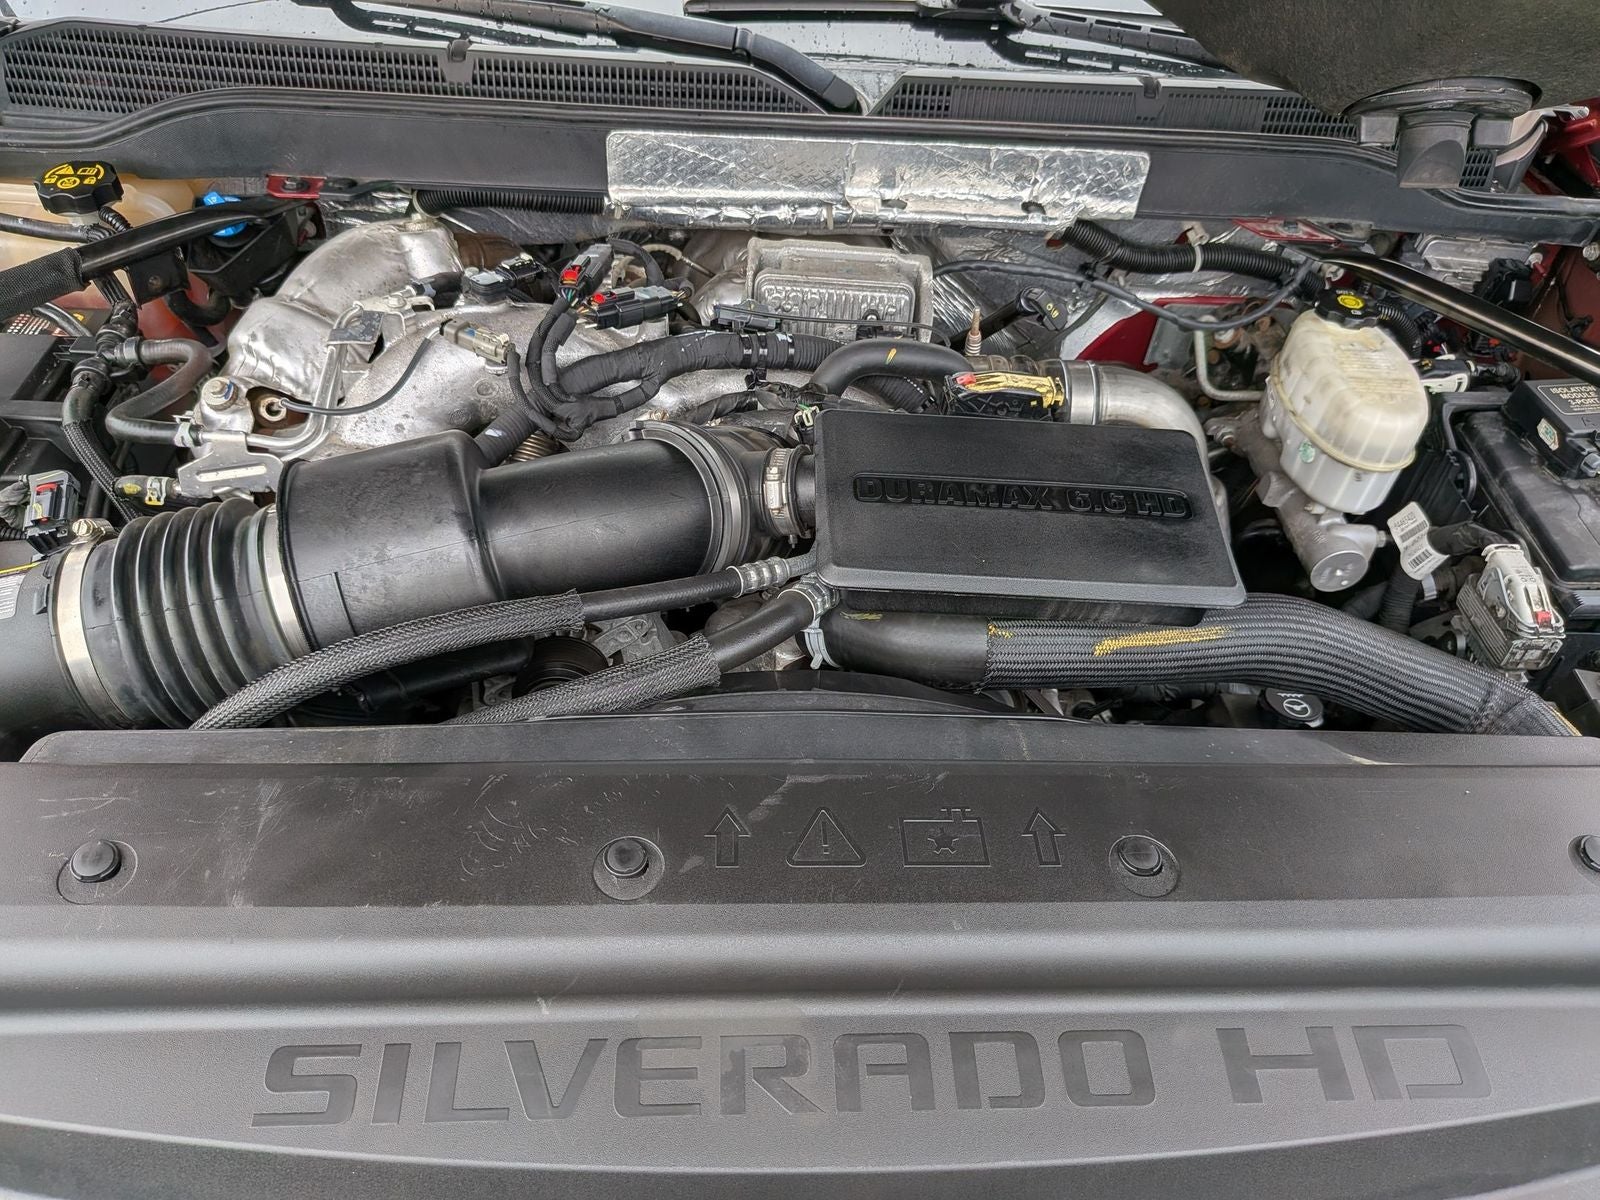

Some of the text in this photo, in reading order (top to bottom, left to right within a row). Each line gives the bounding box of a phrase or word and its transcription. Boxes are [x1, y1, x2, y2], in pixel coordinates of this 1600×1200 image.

[1550, 385, 1597, 394] ISOLATION
[1560, 391, 1599, 399] MODULE
[857, 478, 1188, 517] DURAMAX 6.6 HD
[251, 1023, 1493, 1128] SILVERADO HD
